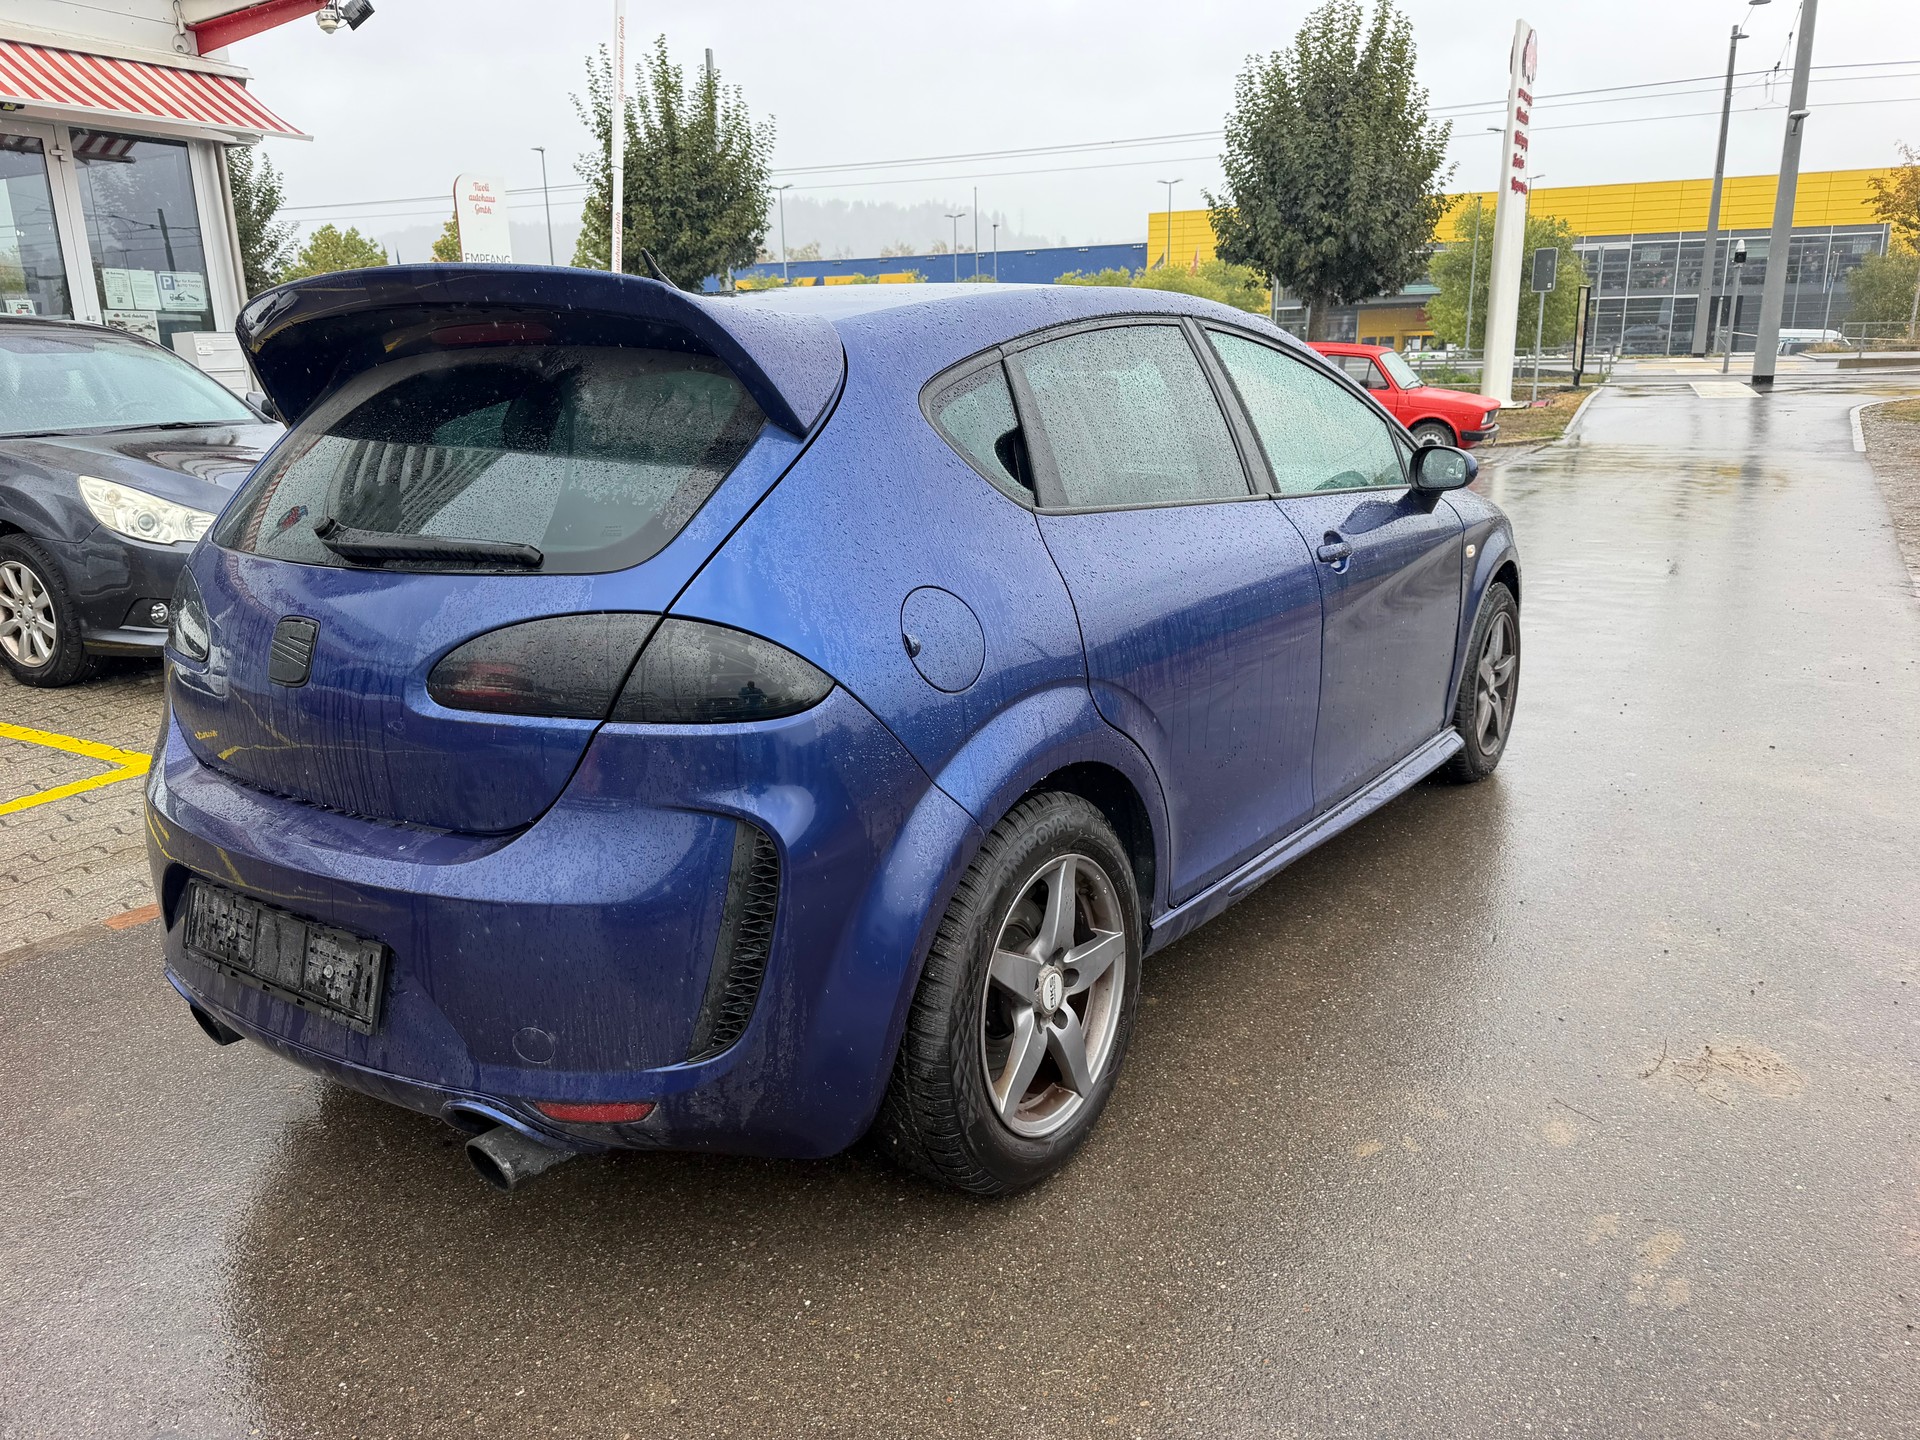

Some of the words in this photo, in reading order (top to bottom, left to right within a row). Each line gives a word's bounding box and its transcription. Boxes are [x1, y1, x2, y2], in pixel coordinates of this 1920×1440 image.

[473, 182, 490, 192] Tivoli
[468, 193, 496, 203] autohaus
[465, 252, 511, 264] EMPFANG
[162, 276, 172, 289] P
